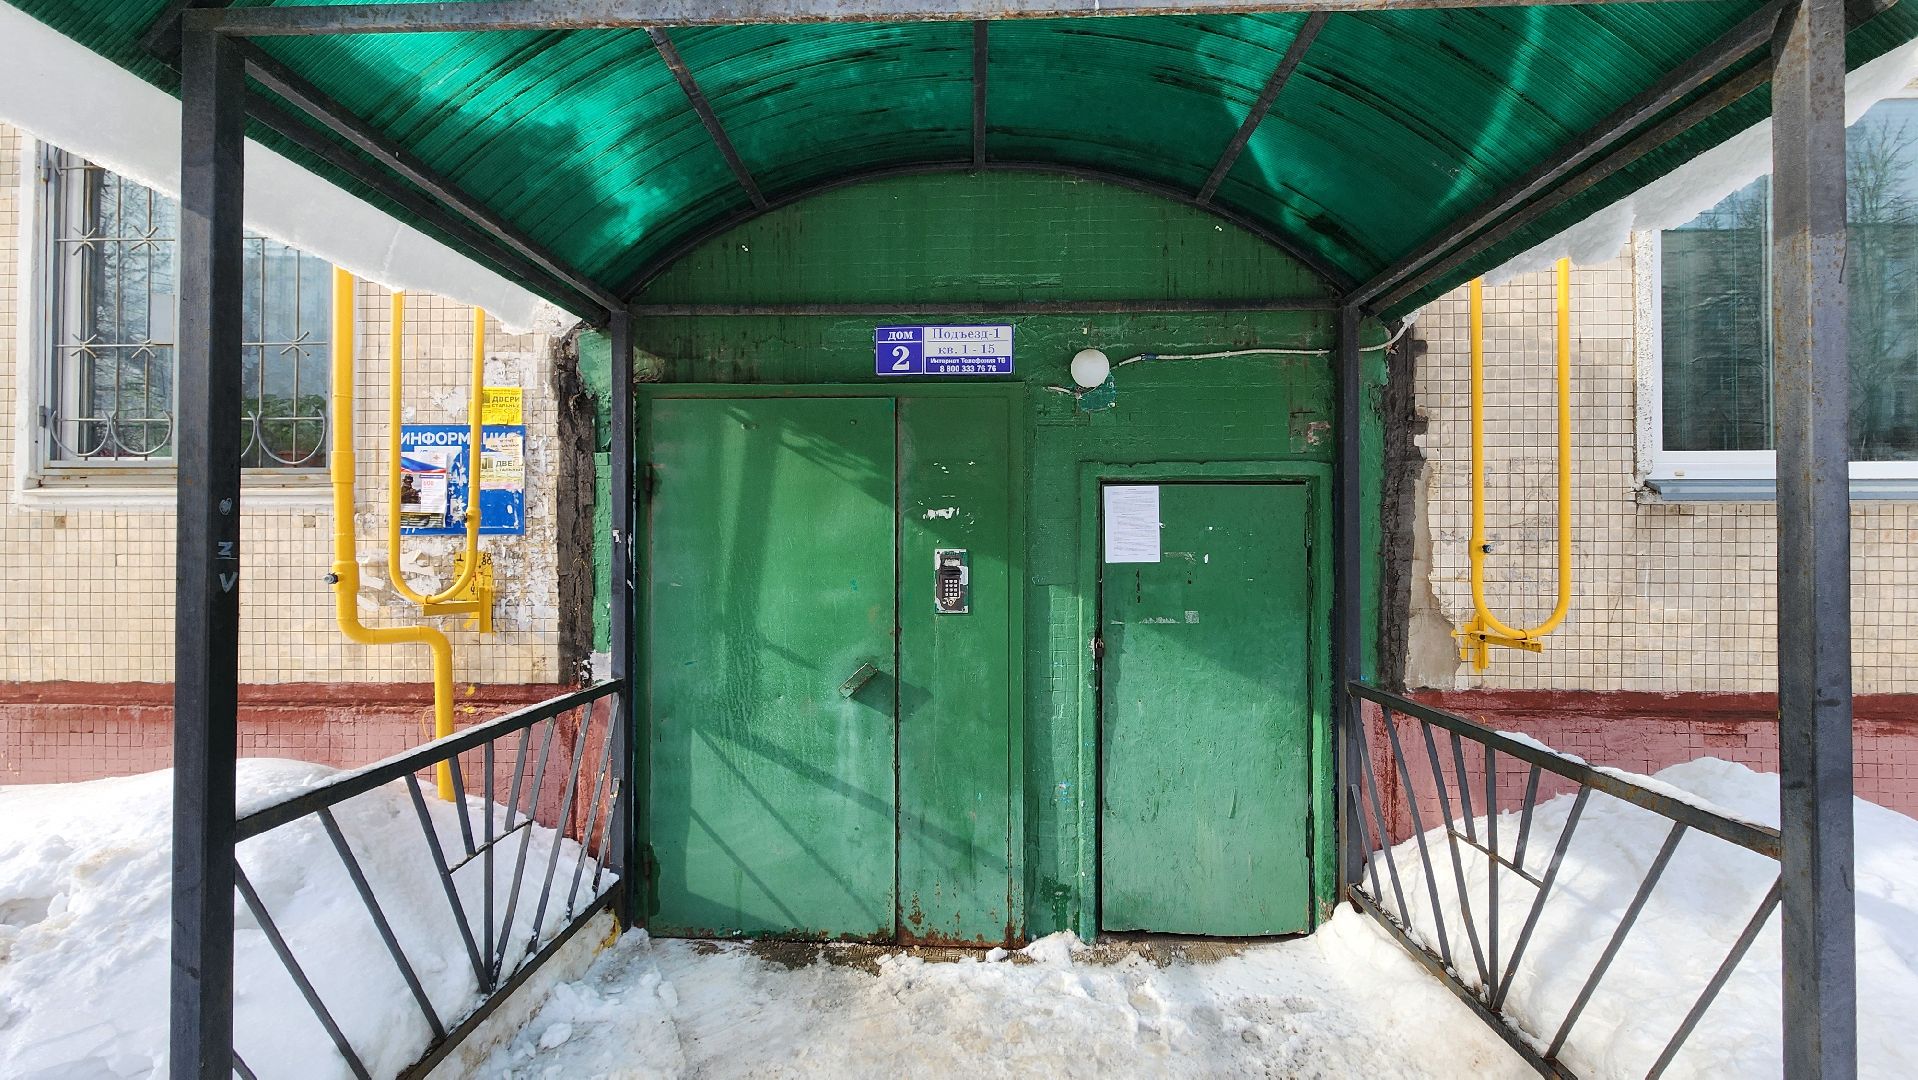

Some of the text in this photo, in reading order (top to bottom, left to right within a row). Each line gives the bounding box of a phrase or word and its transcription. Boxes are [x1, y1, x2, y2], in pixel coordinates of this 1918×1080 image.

[932, 328, 1000, 340] Подъезд-1
[938, 346, 958, 354] кв.
[963, 345, 968, 354] 1
[981, 344, 995, 354] 15
[892, 346, 910, 370] 2
